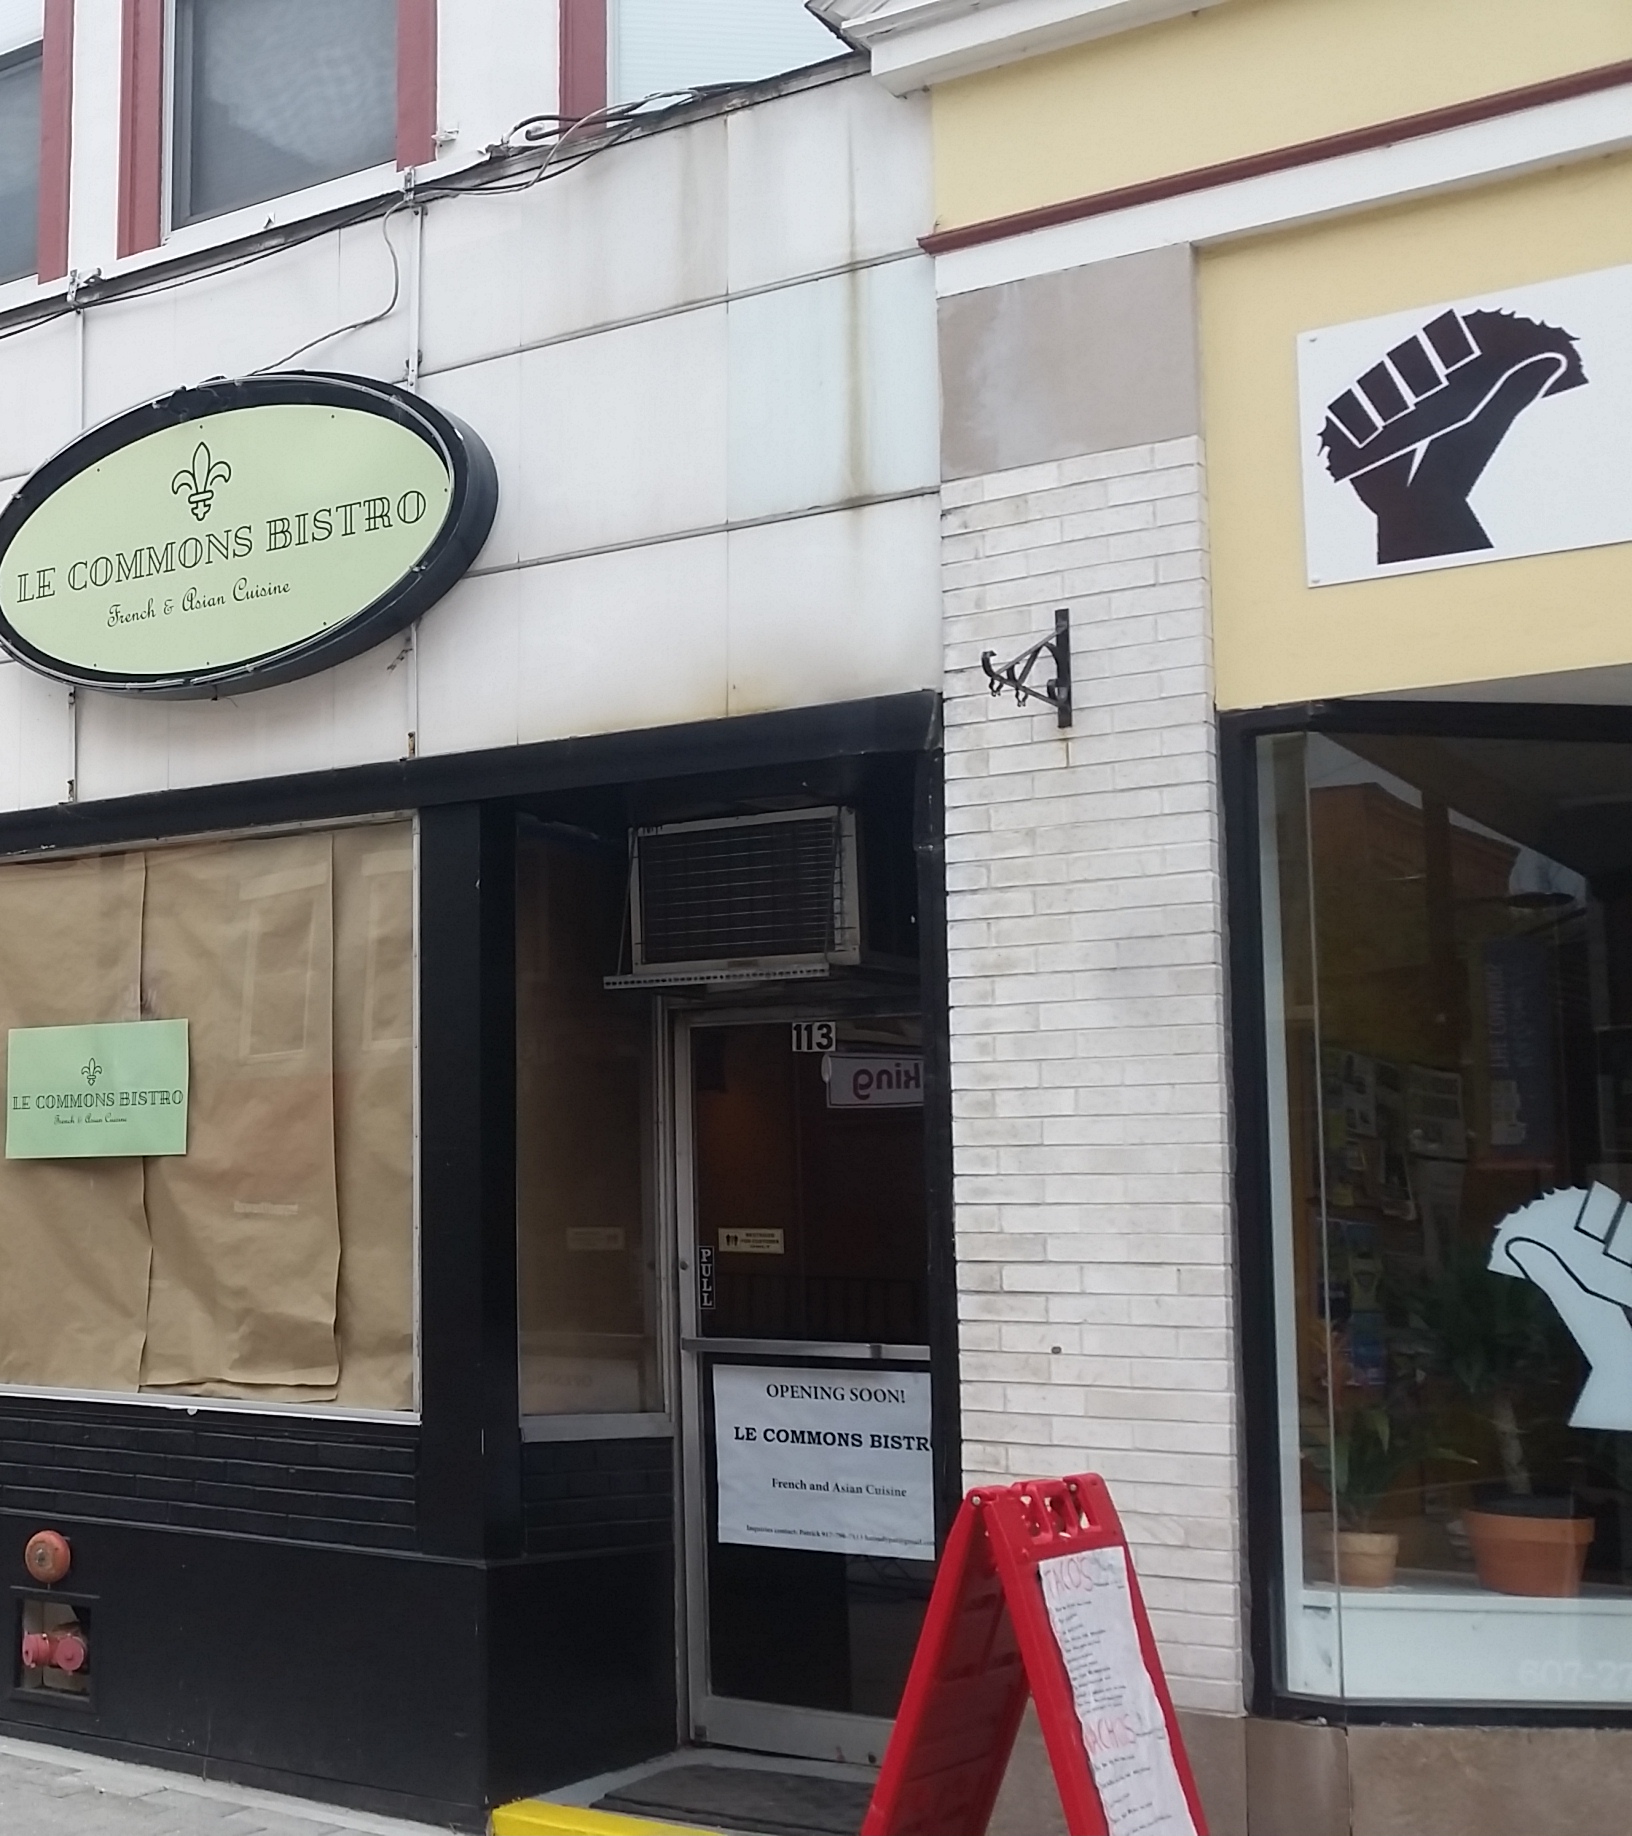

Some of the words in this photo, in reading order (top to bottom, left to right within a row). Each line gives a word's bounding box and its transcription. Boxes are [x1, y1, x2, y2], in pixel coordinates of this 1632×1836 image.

[16, 567, 56, 604] LE
[68, 525, 254, 592] COMMONS
[266, 490, 427, 552] BISTRO
[106, 598, 156, 628] French
[164, 598, 175, 616] &
[181, 587, 226, 612] Asian
[232, 577, 290, 604] Cuisine
[793, 1022, 833, 1051] 113
[12, 1096, 31, 1110] LE
[35, 1093, 115, 1109] COMMONS
[119, 1089, 184, 1107] BISTRO
[700, 1248, 712, 1306] PULL
[766, 1383, 845, 1401] OPENING
[849, 1387, 906, 1403] SOON!
[734, 1426, 757, 1441] LE
[763, 1428, 863, 1447] COMMONS
[870, 1434, 931, 1451] BISTR
[772, 1478, 807, 1490] French
[809, 1481, 829, 1492] and
[832, 1483, 863, 1494] Asian
[865, 1484, 907, 1497] Cuisine
